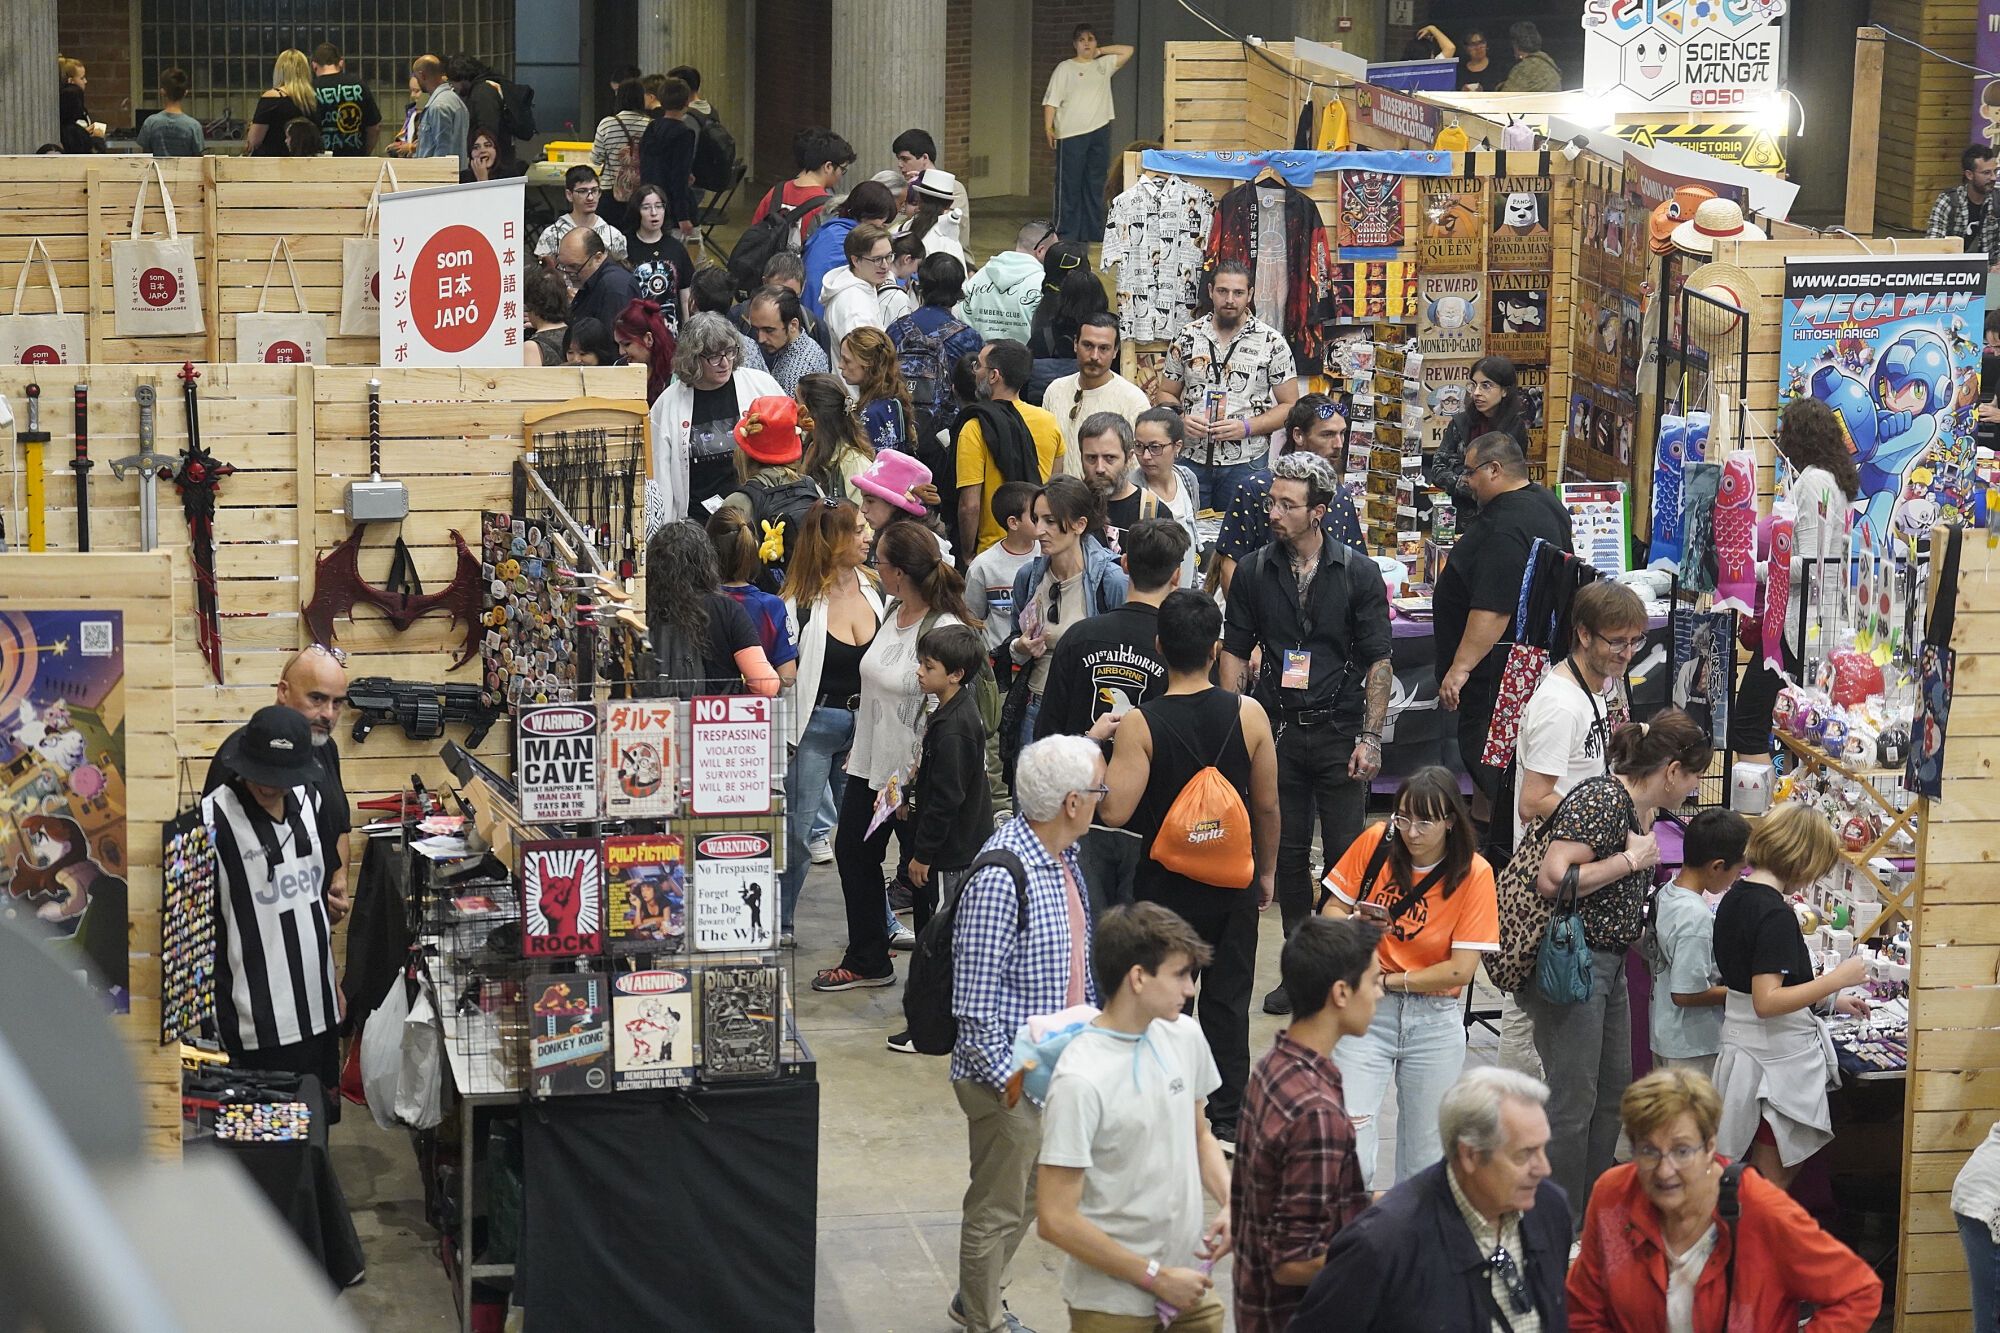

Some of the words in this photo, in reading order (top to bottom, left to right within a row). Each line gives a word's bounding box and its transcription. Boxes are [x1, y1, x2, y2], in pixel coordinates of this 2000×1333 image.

[1686, 42, 1770, 61] SCIENCE
[316, 84, 363, 104] NEVER
[1421, 178, 1482, 194] WANTED
[1492, 178, 1552, 192] WANTED
[1358, 222, 1388, 232] CROSS
[1356, 233, 1388, 244] GUILD
[1428, 244, 1472, 259] QUEEN
[1494, 243, 1548, 254] PANDAMAN
[437, 250, 472, 269] som
[438, 274, 472, 300] 日本
[503, 222, 517, 346] 日本語教室
[1426, 279, 1478, 292] REWARD
[1490, 274, 1550, 290] WANTED
[148, 291, 168, 300] JAPÓ
[393, 236, 408, 362] ソムジャポ
[434, 300, 479, 329] JAPÓ
[1790, 292, 1895, 326] MEGA
[1900, 292, 1972, 316] MAN
[1794, 329, 1841, 340] HITOSHI
[1844, 328, 1880, 340] ARIGA
[1106, 644, 1164, 678] AIRBORNE
[1096, 667, 1144, 682] AIRBORNE
[696, 700, 726, 721] NO
[532, 714, 584, 730] WARNING
[610, 707, 671, 732] ダルマ
[697, 729, 766, 740] TRESPASSING
[524, 738, 593, 762] MAN
[706, 746, 756, 756] VIOLATORS
[700, 760, 721, 768] WILL
[726, 758, 736, 767] BE
[740, 758, 764, 766] SHOT
[524, 762, 594, 784] CAVE
[706, 770, 757, 780] SURVIVORS
[700, 783, 721, 792] WILL
[726, 782, 736, 791] BE
[740, 782, 764, 790] SHOT
[716, 795, 745, 804] AGAIN
[1188, 828, 1224, 843] Spritz
[608, 847, 636, 863] PULP
[638, 844, 680, 862] FICTION
[706, 840, 762, 854] WARNING
[698, 864, 711, 874] No
[714, 862, 770, 876] Trespassing
[255, 866, 322, 905] Jeep
[698, 889, 728, 900] Forget
[699, 904, 718, 914] The
[722, 903, 742, 914] Dog
[698, 918, 724, 926] Beware
[532, 934, 594, 952] ROCK
[698, 929, 728, 942] The
[619, 973, 686, 991] WARNING
[537, 1038, 576, 1057] DONKEY
[578, 1031, 604, 1047] KONG
[624, 1070, 664, 1080] REMEMBER
[616, 1080, 650, 1092] ELECTRICITY
[651, 1079, 665, 1088] WILL
[666, 1078, 678, 1088] KILL
